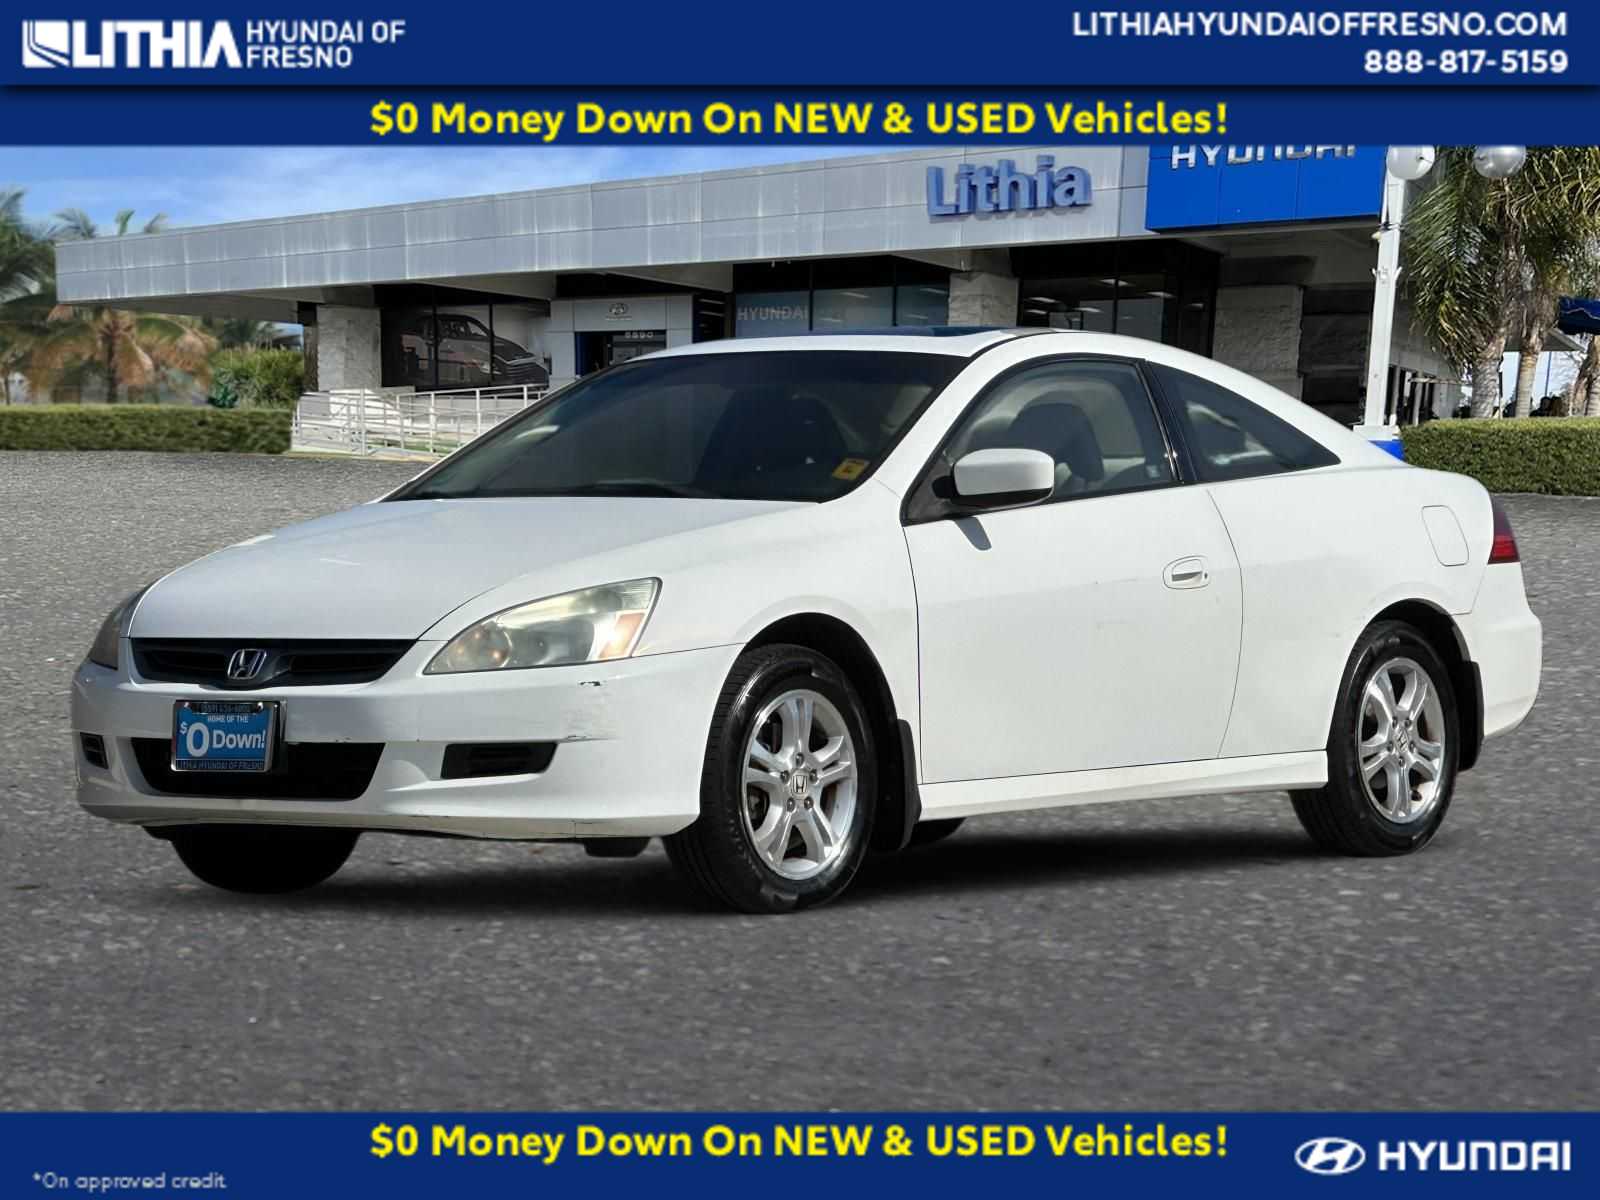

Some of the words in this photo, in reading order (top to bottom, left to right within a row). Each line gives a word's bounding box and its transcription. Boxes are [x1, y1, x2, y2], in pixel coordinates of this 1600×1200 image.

[926, 155, 1093, 217] Lithia
[737, 305, 809, 321] HYUNDAI
[226, 714, 235, 723] OF
[236, 714, 249, 723] THE
[212, 729, 266, 749] Down!
